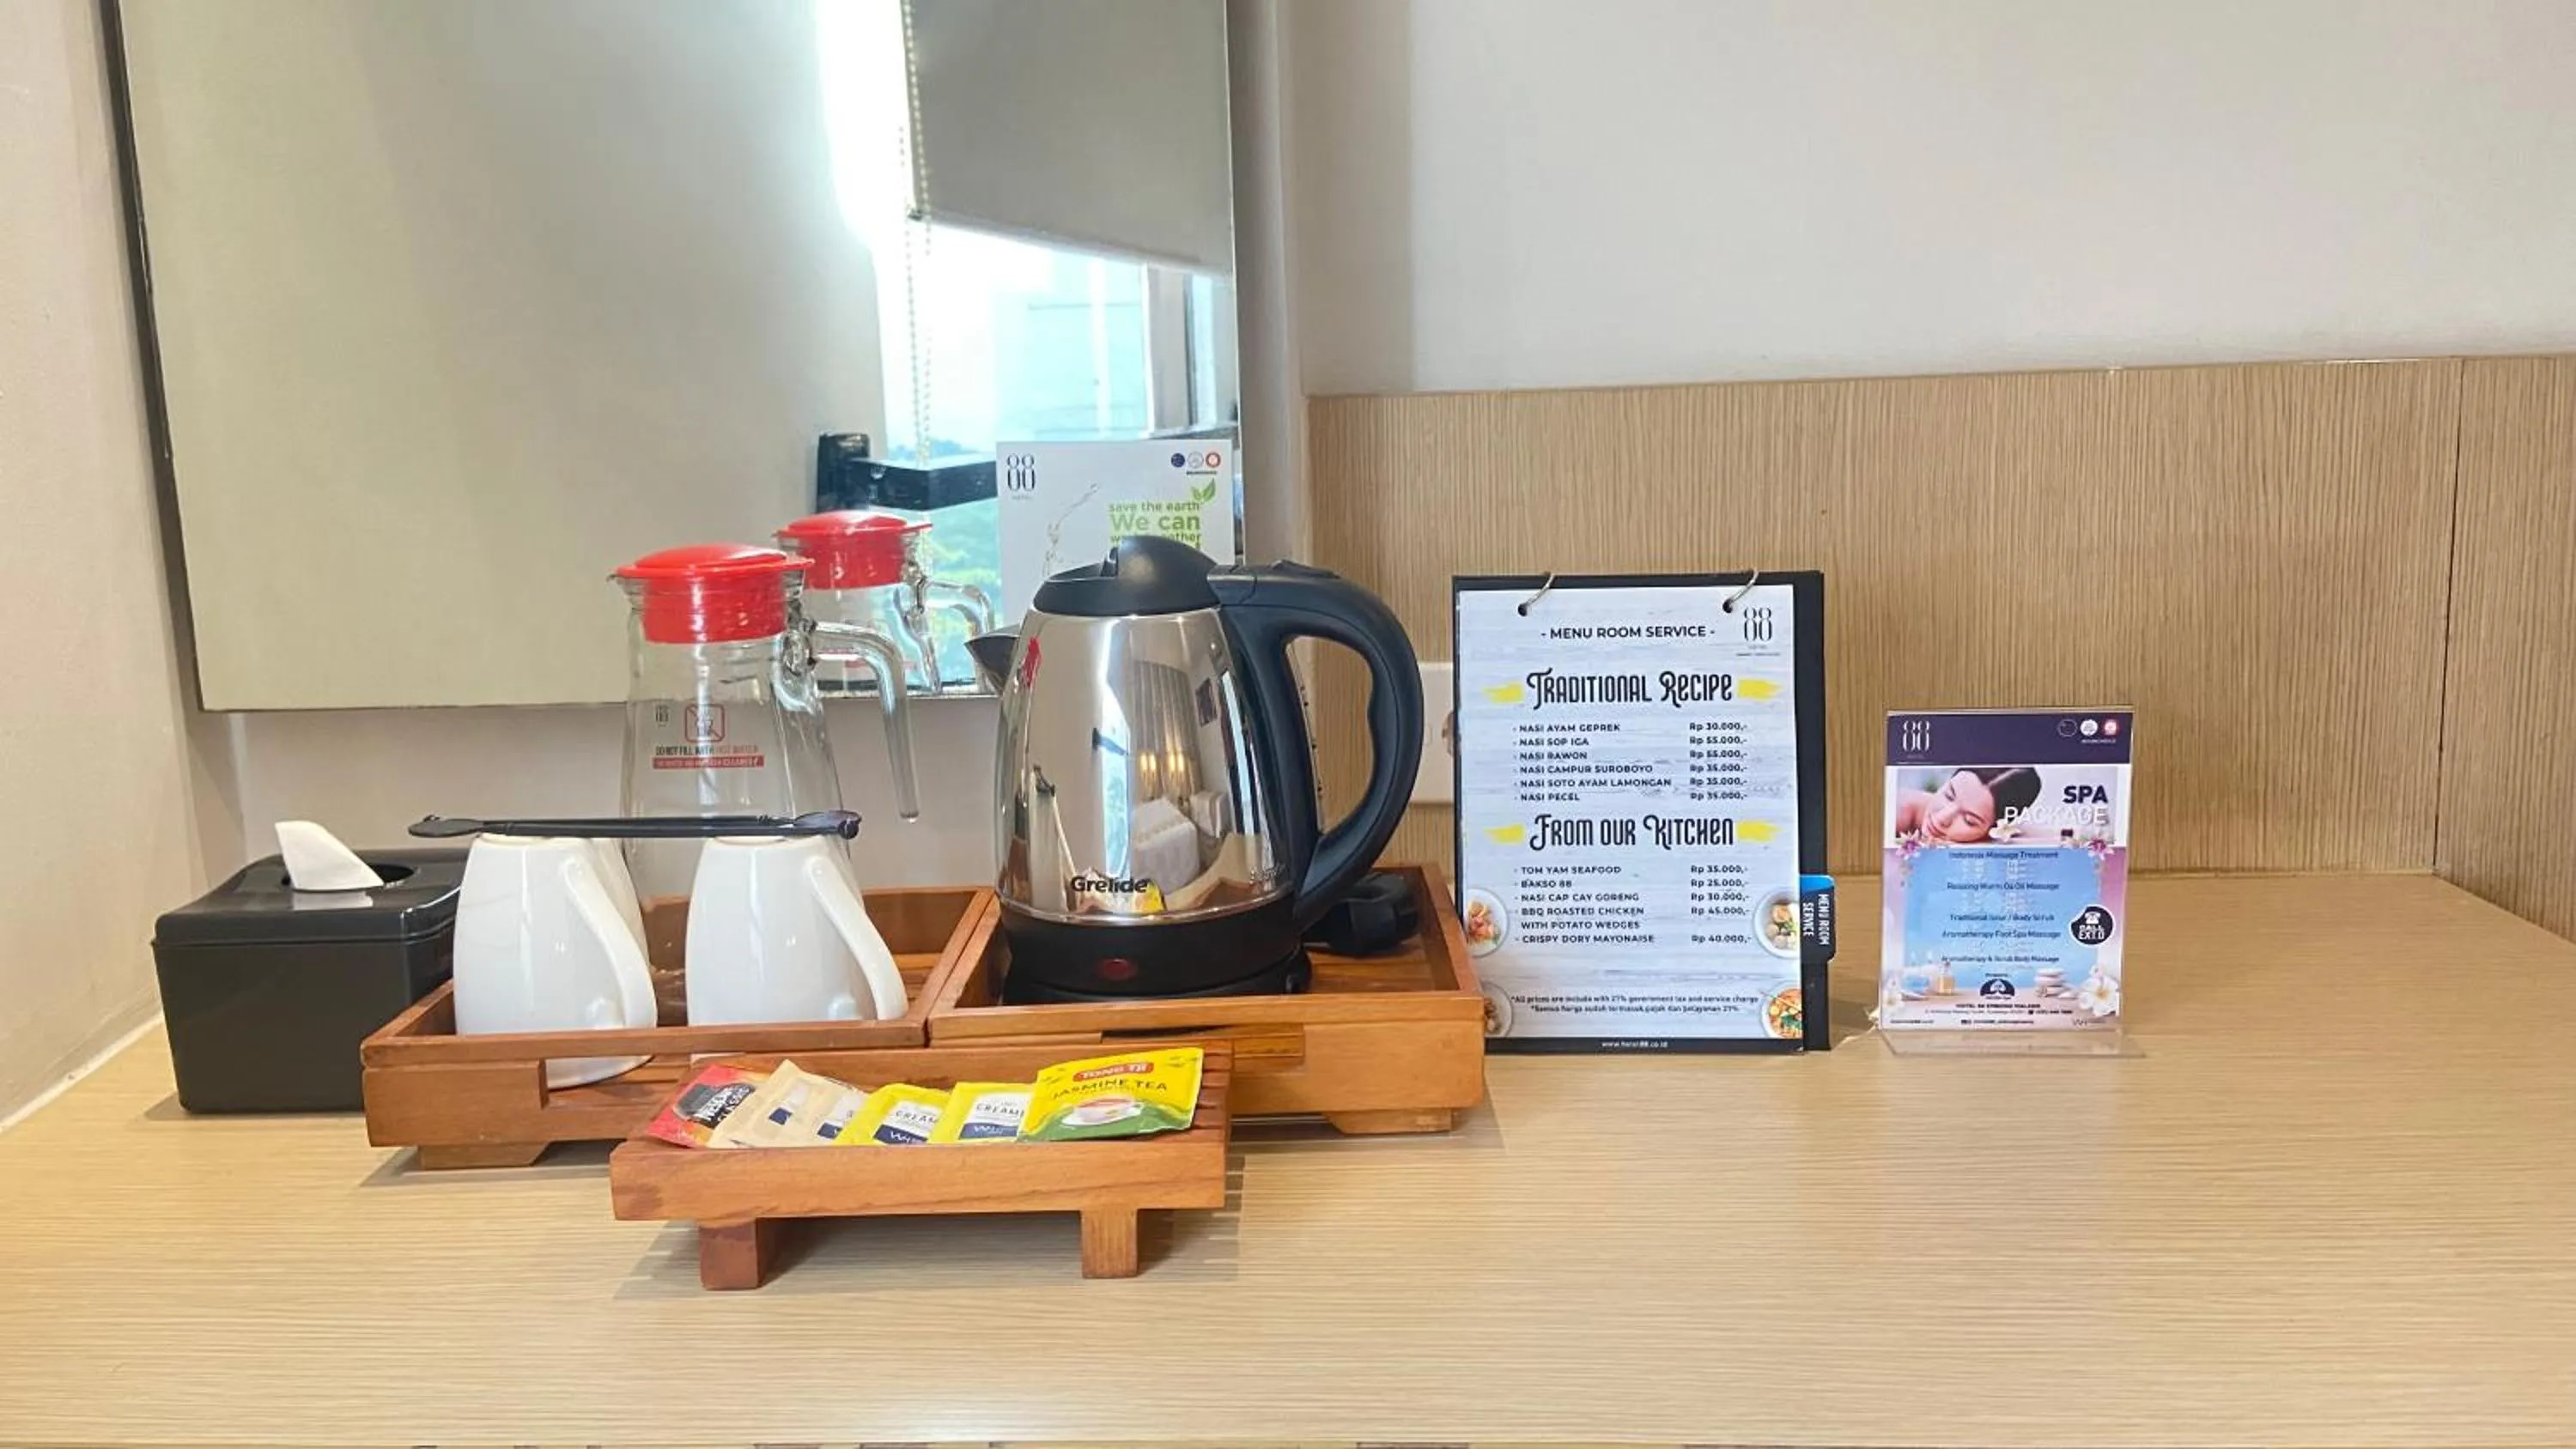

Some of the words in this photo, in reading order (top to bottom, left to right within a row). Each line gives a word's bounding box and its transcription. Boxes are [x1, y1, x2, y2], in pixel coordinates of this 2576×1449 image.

[1141, 501, 1162, 512] the
[1166, 501, 1200, 512] earth
[1111, 515, 1149, 530] We
[1158, 516, 1200, 530] can
[1744, 608, 1772, 641] 88
[1550, 627, 1593, 639] MENU
[1596, 627, 1642, 638] ROOM
[1646, 626, 1706, 638] SERVICE
[1519, 724, 1544, 732] NASI
[1546, 724, 1576, 732] AYAM
[1579, 724, 1620, 732] GEPREK
[1690, 722, 1704, 731] Rp
[1690, 736, 1704, 744] Rp
[1690, 749, 1704, 759] Rp
[1690, 763, 1704, 773] Rp
[1521, 779, 1545, 787] NASI
[1547, 779, 1576, 787] SOTO
[1578, 779, 1607, 787] AYAM
[1610, 779, 1672, 787] LAMONGAN
[1690, 777, 1704, 786] Rp
[1521, 792, 1545, 801] NASI
[1548, 792, 1580, 801] PECEL
[1690, 791, 1704, 801] Rp
[2063, 785, 2108, 803] SPA
[2004, 806, 2110, 825] PACKAGE
[1691, 864, 1704, 874] Rp
[1071, 876, 1151, 893] Grelide
[1691, 879, 1704, 888] Rp
[1691, 893, 1704, 901] Rp
[1522, 907, 1544, 916] BBQ
[1546, 907, 1595, 916] ROASTED
[1598, 907, 1644, 916] CHICKEN
[1691, 906, 1704, 916] Rp
[1803, 901, 1814, 937] SERVICE
[1522, 935, 1558, 943] CRISPY
[1562, 935, 1590, 943] DORY
[1593, 935, 1654, 943] MAYONAISE
[1691, 934, 1705, 943] Rp
[1053, 1078, 1128, 1099] JASMINE
[1136, 1081, 1168, 1090] TEA
